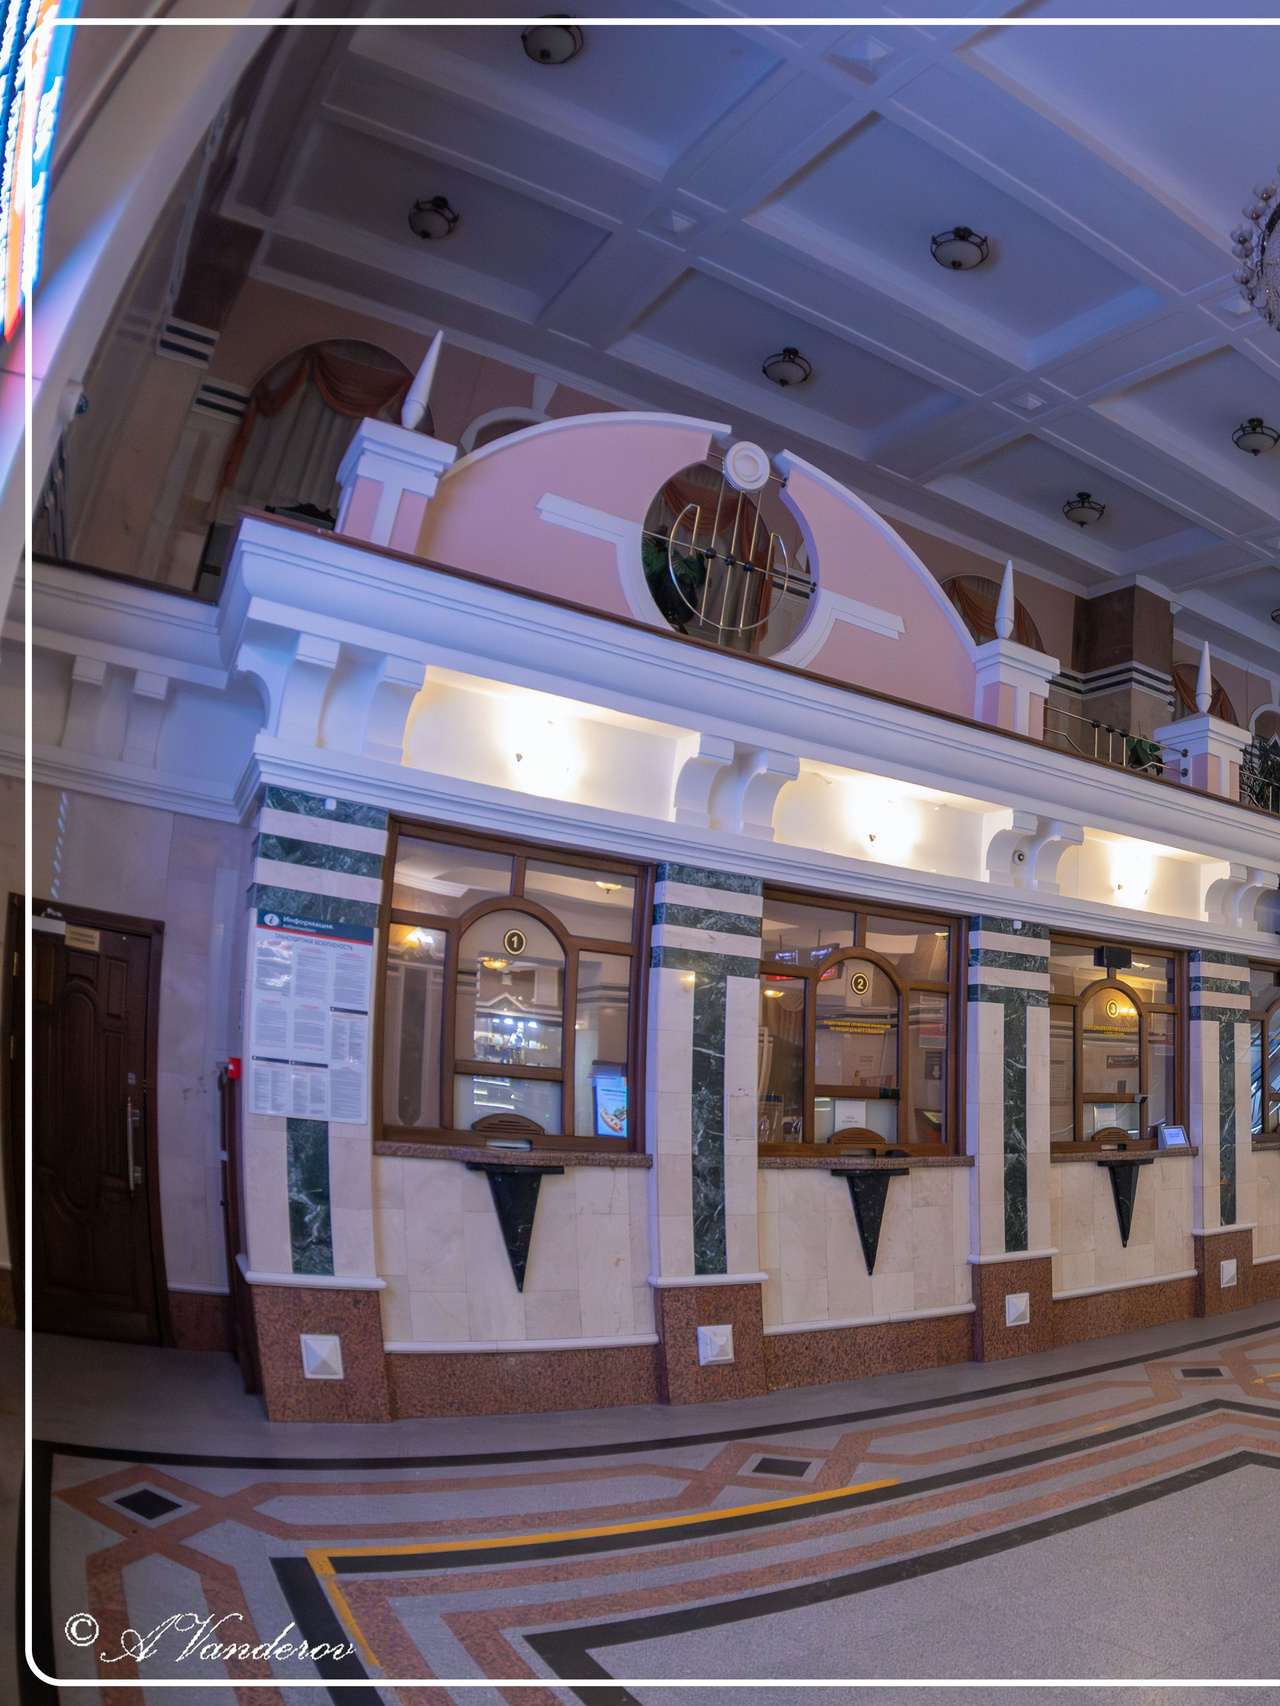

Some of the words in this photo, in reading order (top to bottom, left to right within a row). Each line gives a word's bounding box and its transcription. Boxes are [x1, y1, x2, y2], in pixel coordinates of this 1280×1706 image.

[283, 916, 334, 930] Информация
[511, 935, 518, 949] 1
[857, 978, 864, 989] 2
[1110, 1004, 1116, 1014] 3
